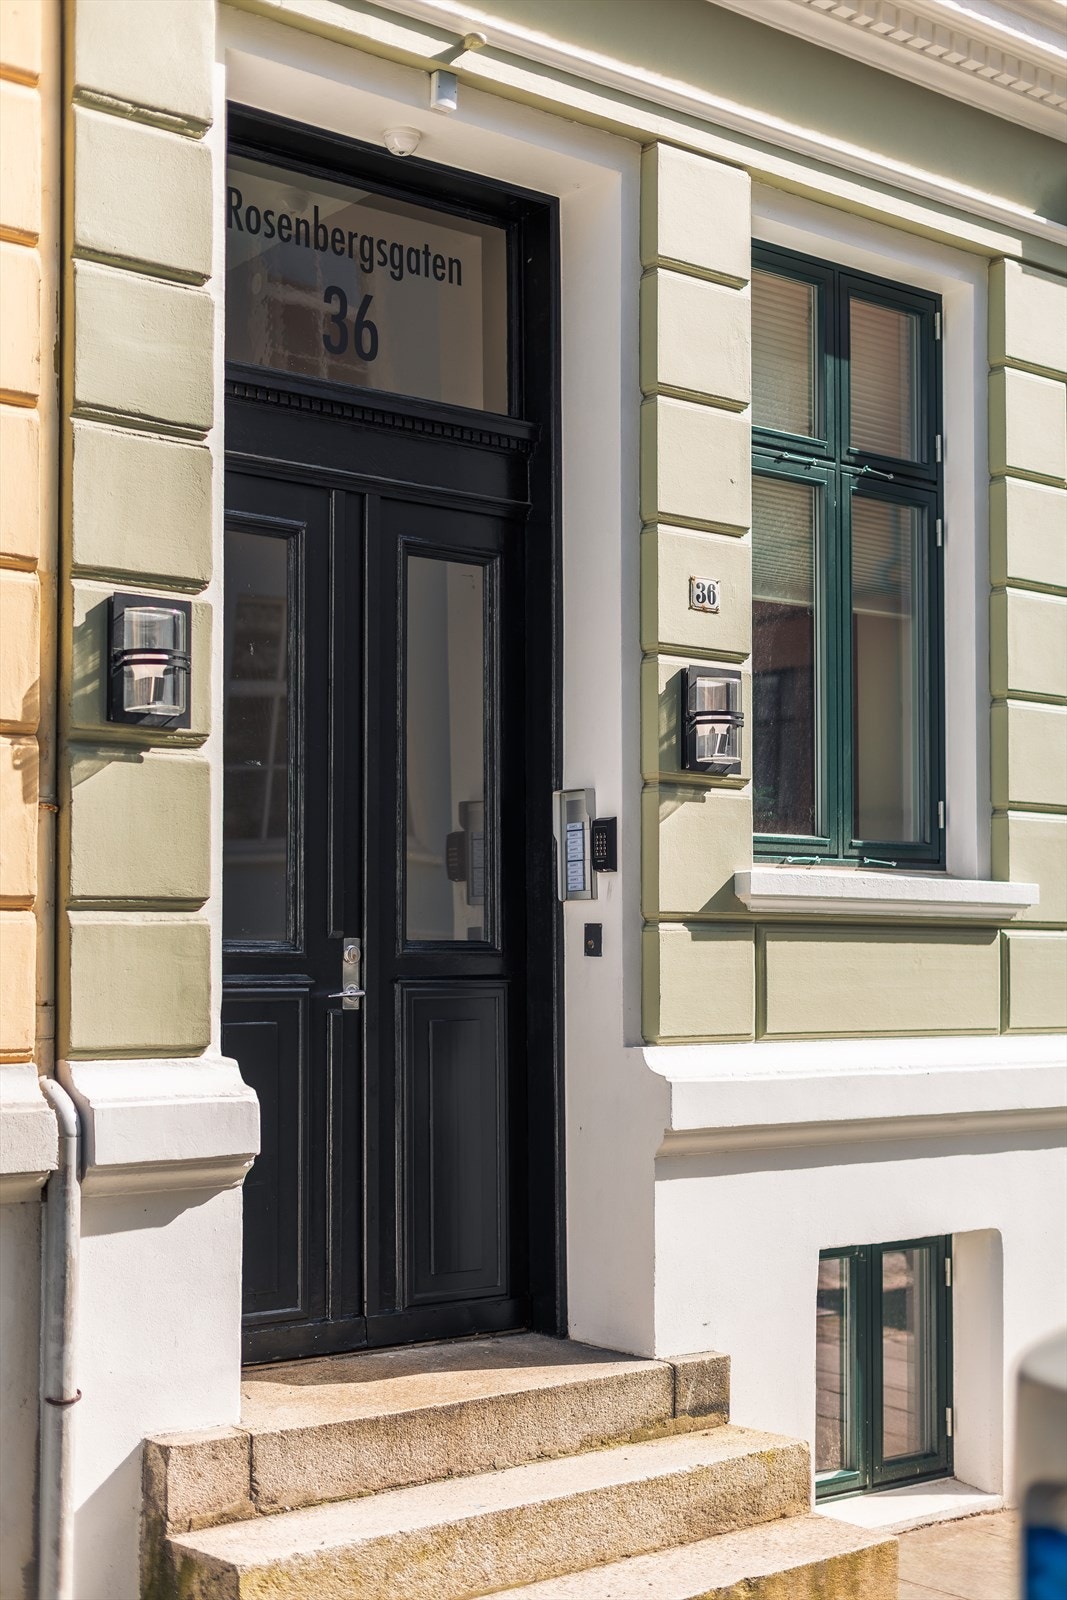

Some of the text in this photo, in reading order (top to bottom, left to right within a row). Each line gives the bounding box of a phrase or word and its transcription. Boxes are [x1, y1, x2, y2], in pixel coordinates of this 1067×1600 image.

[226, 186, 462, 286] Rosenbergsgaten
[322, 285, 379, 362] 36
[695, 582, 717, 605] 36
